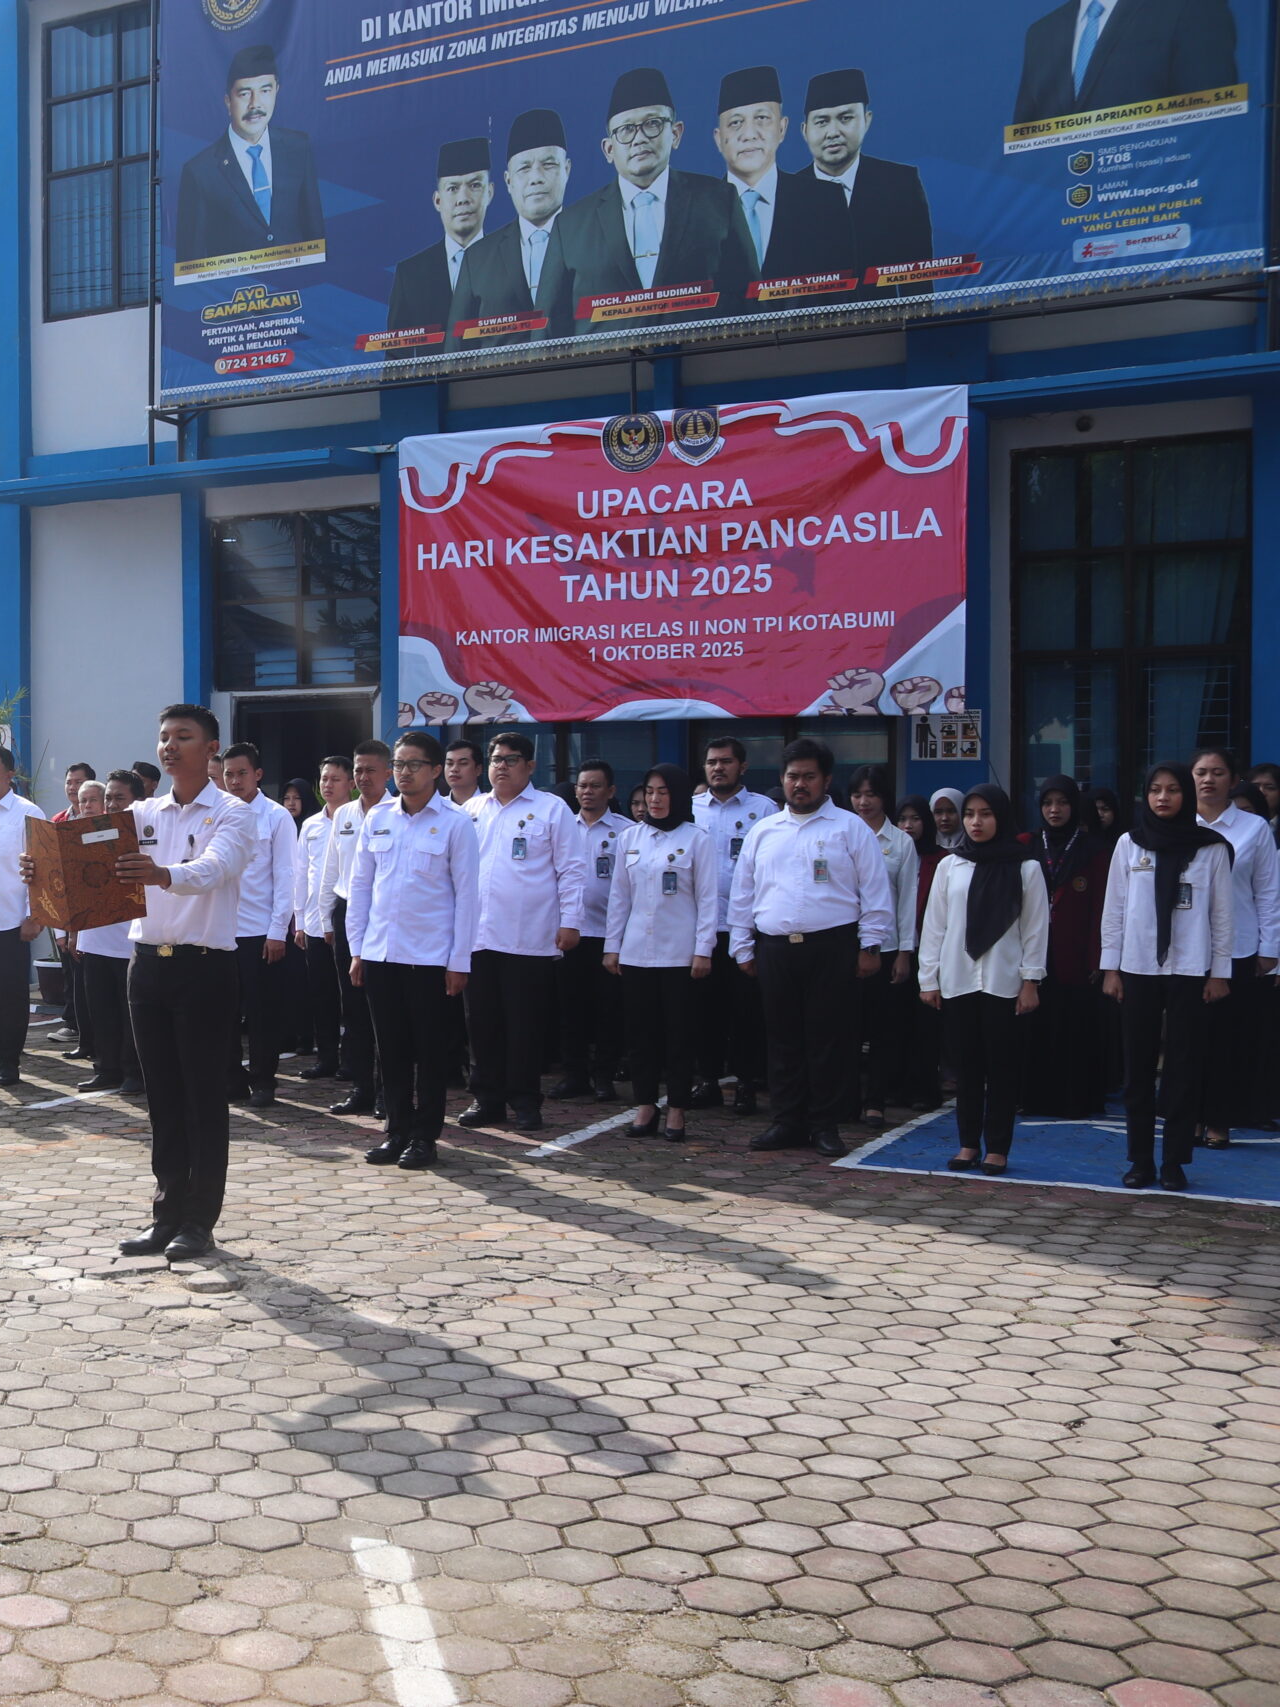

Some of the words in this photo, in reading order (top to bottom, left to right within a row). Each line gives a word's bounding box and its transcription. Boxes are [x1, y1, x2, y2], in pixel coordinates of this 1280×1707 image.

[361, 16, 381, 42] DI
[388, 0, 472, 36] KANTOR
[324, 63, 362, 86] ANDA
[366, 45, 444, 77] MEMASUKI
[447, 36, 487, 60] ZONA
[491, 16, 578, 50] INTEGRITAS
[581, 1, 650, 31] MENUJU
[1013, 122, 1052, 137] PETRUS
[1055, 116, 1092, 130] TEGUH
[1095, 104, 1153, 122] APRIANTO
[1214, 89, 1237, 101] S.H.
[1008, 142, 1032, 151] KEPALA
[1033, 137, 1061, 147] KANTOR
[1062, 132, 1091, 141] WILAYAH
[1093, 124, 1134, 136] DIREKTORAT
[1097, 147, 1117, 156] SMS
[1119, 136, 1177, 152] PENGADUAN
[1097, 152, 1132, 166] 1708
[1097, 162, 1134, 174] Kumham
[1135, 157, 1163, 170] (spasi)
[1164, 152, 1191, 163] aduan
[1097, 180, 1128, 191] LAMAN
[1061, 213, 1100, 226] UNTUK
[1103, 205, 1156, 219] LAYANAN
[1159, 197, 1203, 210] PUBLIK
[1082, 222, 1112, 233] YANG
[1116, 216, 1149, 228] LEBIH
[1153, 211, 1181, 223] BAIK
[1126, 232, 1178, 246] BerAKHLAK
[876, 263, 915, 275] TEMMY
[918, 256, 963, 269] TARMIZI
[758, 280, 788, 290] ALLEN
[805, 273, 840, 284] YUHAN
[887, 275, 907, 284] KASI
[234, 287, 265, 302] AYO
[591, 297, 622, 308] MOCH.
[624, 292, 654, 304] ANDRI
[656, 286, 702, 299] BUDIMAN
[769, 289, 790, 297] KASI
[478, 315, 517, 326] SUWARDI
[601, 307, 633, 317] KEPALA
[201, 323, 257, 337] PERTANYAAN,
[259, 316, 305, 329] ASPRIRASI,
[208, 334, 237, 345] KRITIK
[247, 327, 298, 340] PENGADUAN
[369, 332, 396, 341] DONNY
[398, 328, 425, 337] BAHAR
[222, 343, 244, 353] ANDA
[246, 339, 282, 350] MELALUI
[381, 340, 400, 349] KASI
[220, 359, 247, 370] 0724
[251, 353, 287, 366] 21467
[576, 477, 754, 520] UPACARA
[416, 537, 495, 572] HARI
[505, 523, 710, 566] KESAKTIAN
[720, 506, 943, 553] PANCASILA
[560, 567, 679, 604] TAHUN
[690, 562, 773, 598] 2025
[455, 628, 529, 647] KANTOR
[534, 624, 616, 643] IMIGRASI
[620, 621, 684, 640] KELAS
[689, 620, 700, 636] II
[704, 618, 747, 636] NON
[752, 616, 782, 633] TPI
[788, 611, 896, 632] KOTABUMI
[588, 648, 596, 662] 1
[602, 644, 696, 662] OKTOBER
[701, 640, 744, 658] 2025
